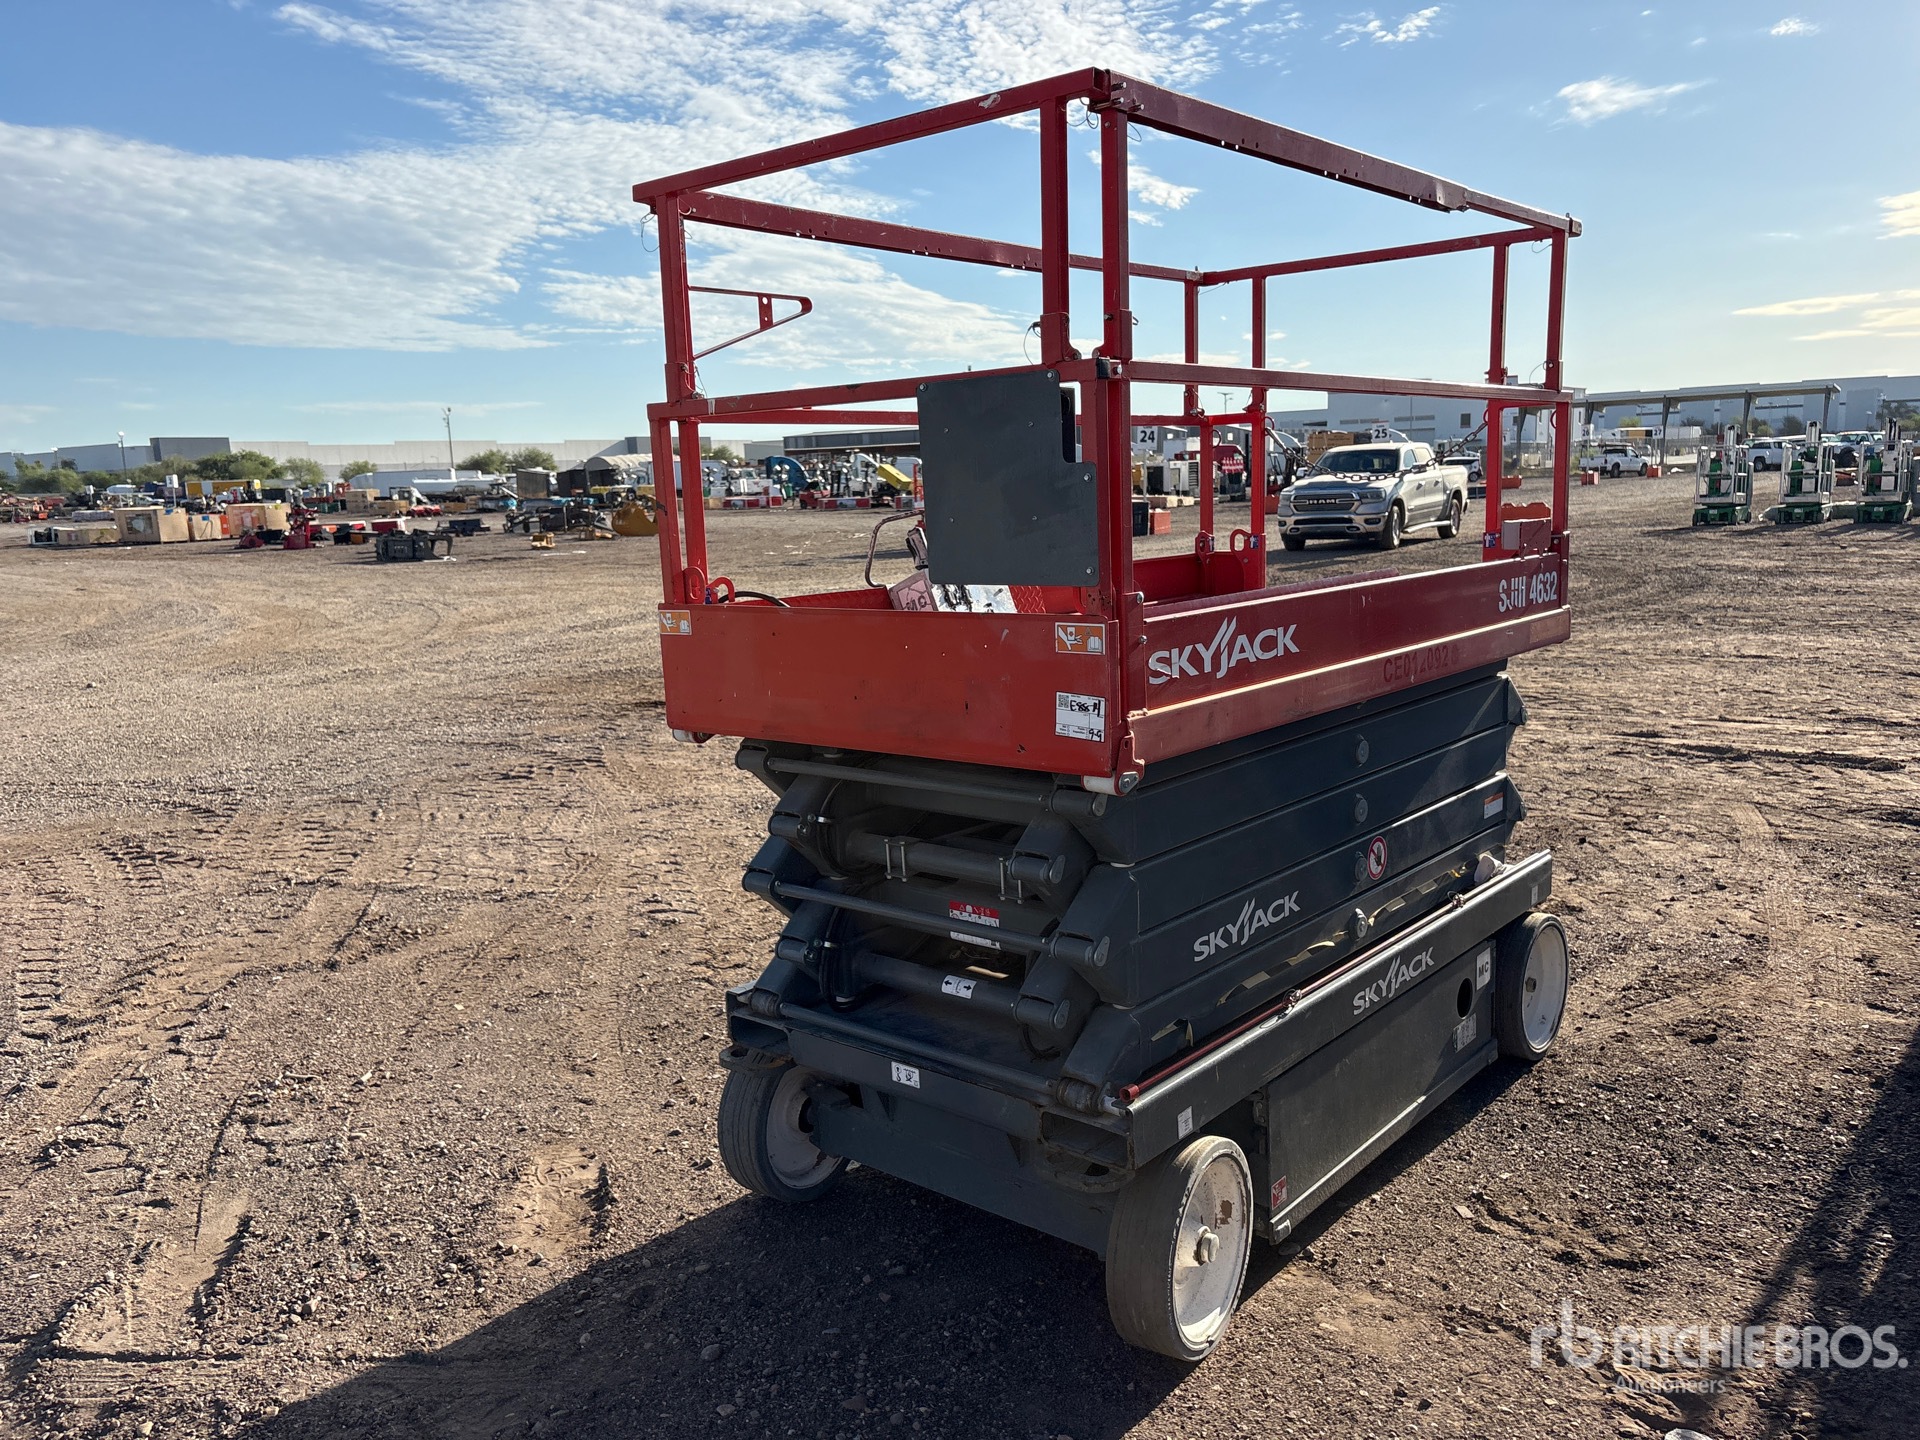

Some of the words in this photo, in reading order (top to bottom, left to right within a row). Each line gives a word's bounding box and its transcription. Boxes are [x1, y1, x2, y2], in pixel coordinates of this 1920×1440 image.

[1140, 430, 1155, 443] 24
[1374, 429, 1388, 439] 25
[1529, 570, 1557, 605] 4632
[1147, 615, 1300, 685] SKYJACK
[1193, 890, 1301, 962] SKYJACK
[1352, 946, 1436, 1016] SKYJACK
[1478, 961, 1490, 978] MC
